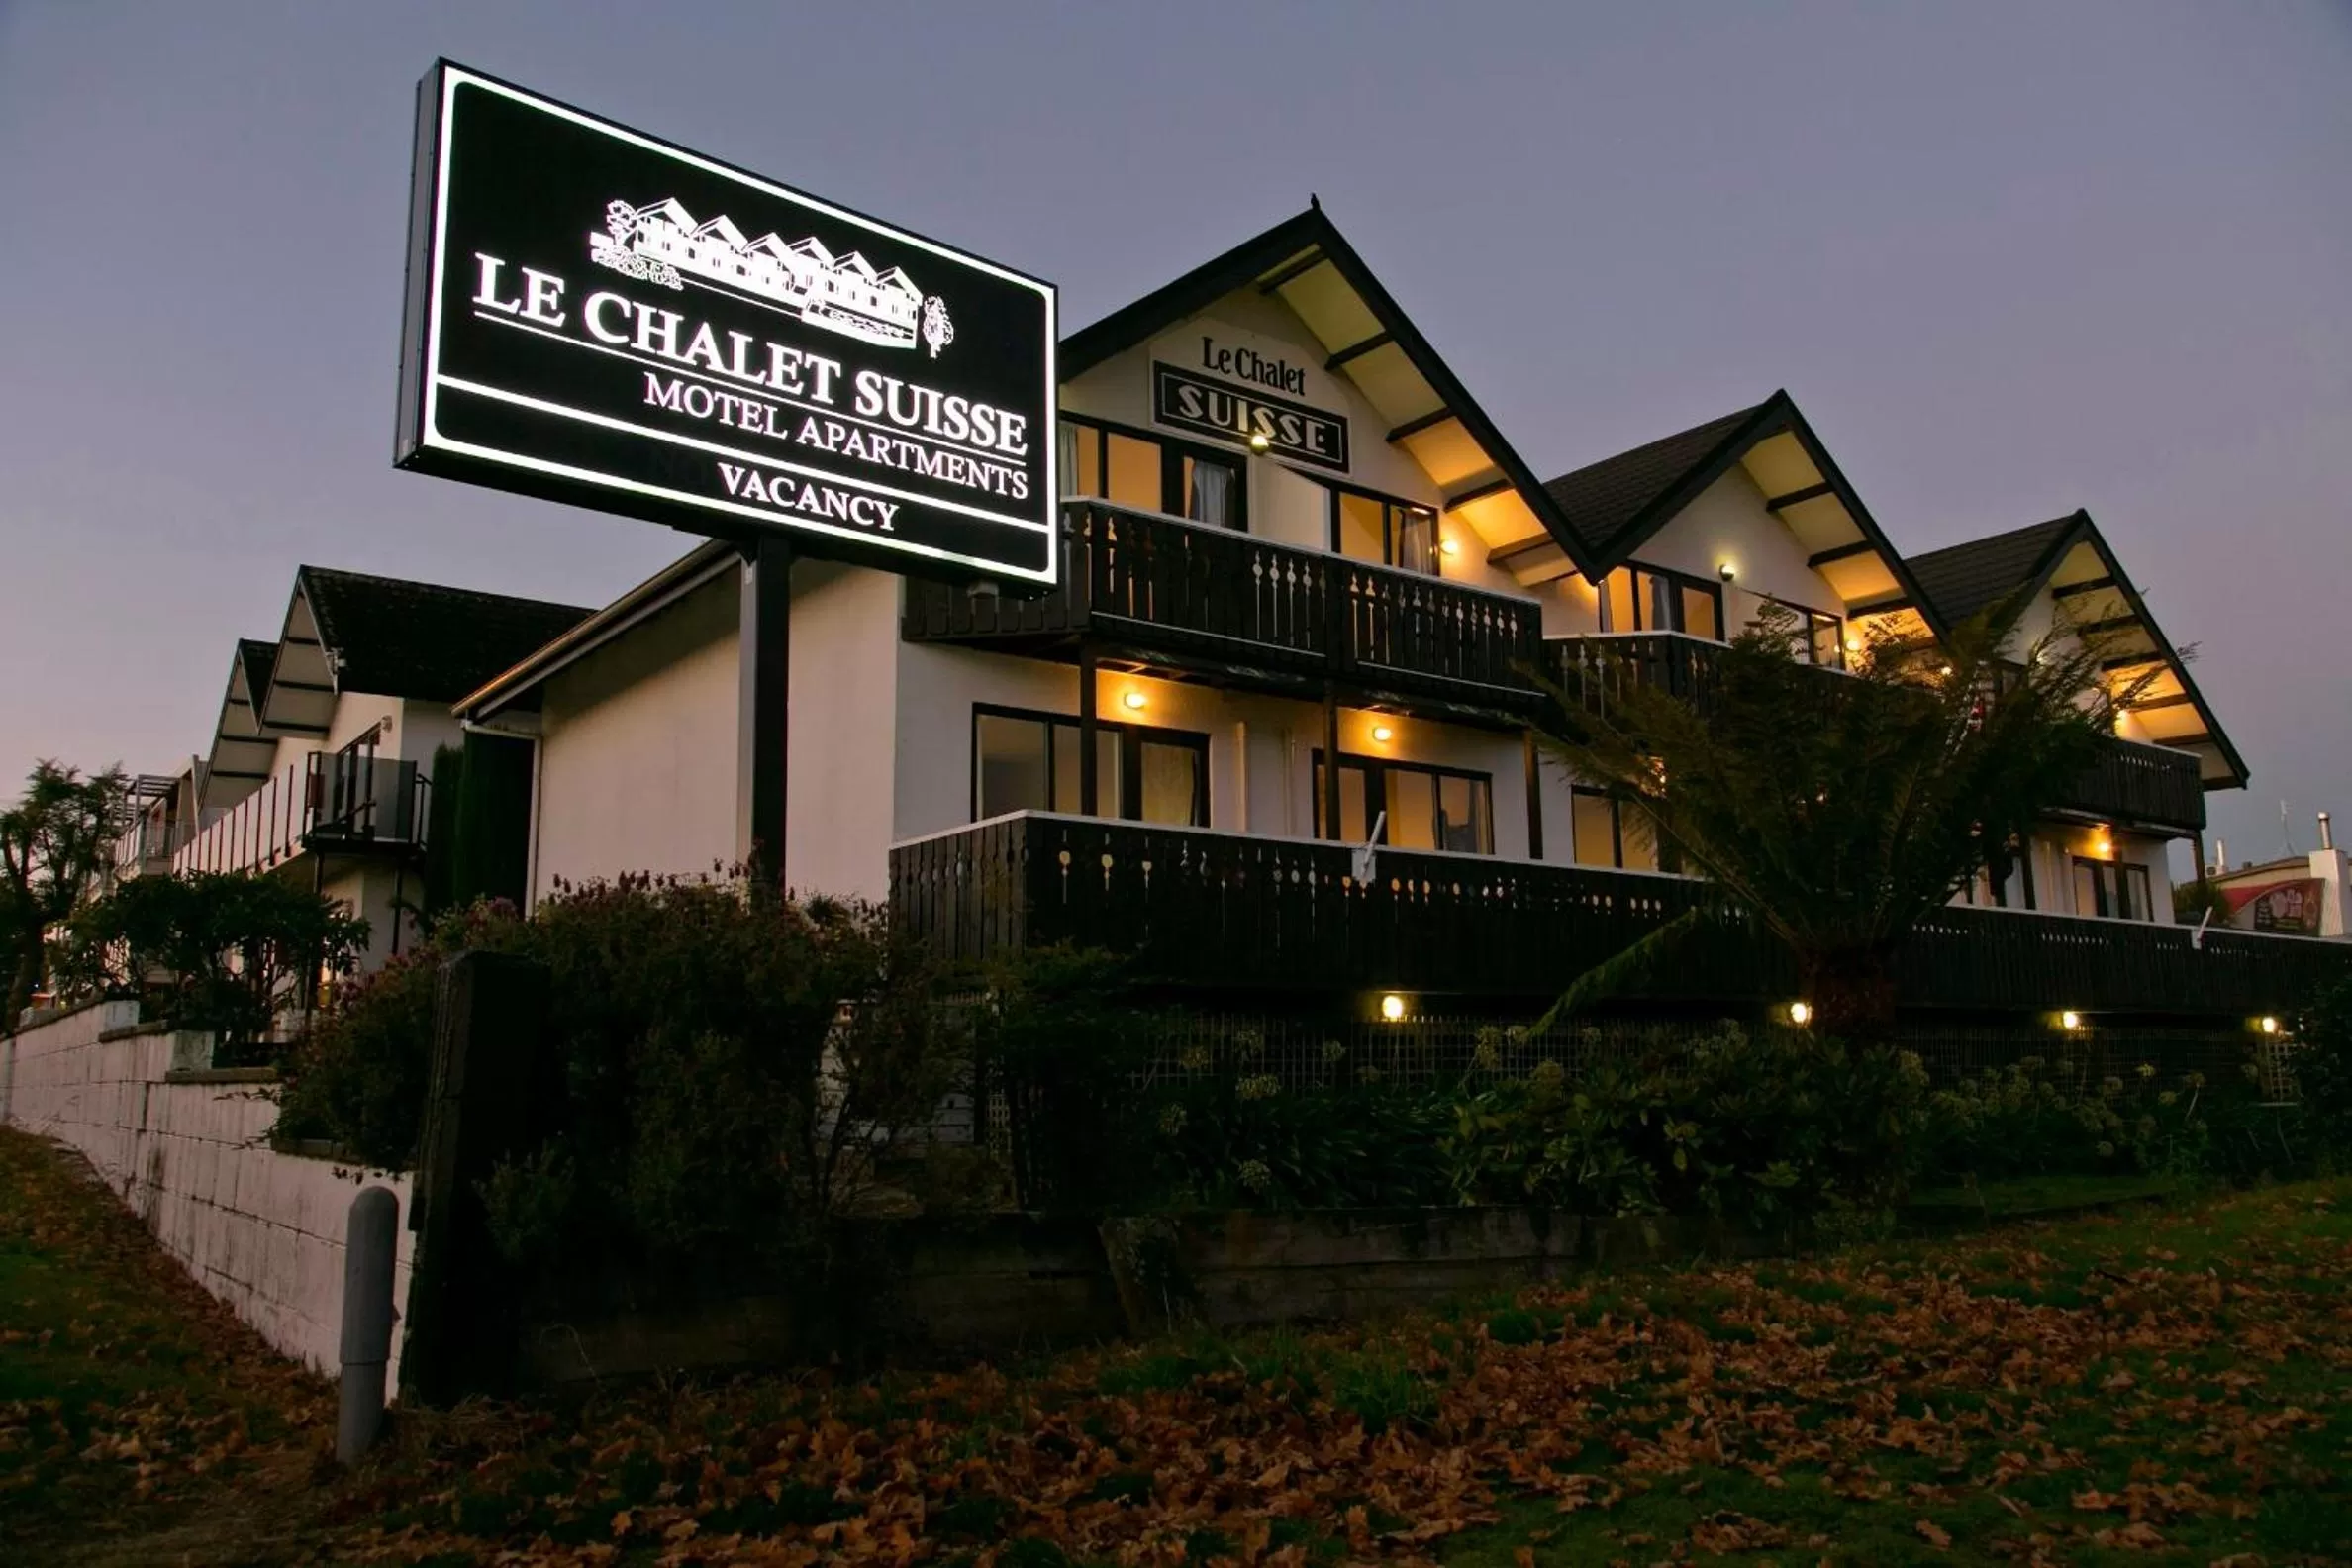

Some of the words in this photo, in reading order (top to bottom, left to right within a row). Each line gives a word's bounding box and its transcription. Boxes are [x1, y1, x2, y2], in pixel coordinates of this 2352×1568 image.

[473, 253, 565, 327] LE
[585, 292, 840, 404] CHALET
[856, 371, 1027, 456] SUISSE
[1202, 337, 1231, 374] Le
[1235, 348, 1306, 396] Chalet
[644, 372, 787, 439] MOTEL
[796, 417, 1028, 500] APARTMENTS
[1178, 385, 1326, 453] SUISSE
[719, 463, 899, 530] VACANCY
